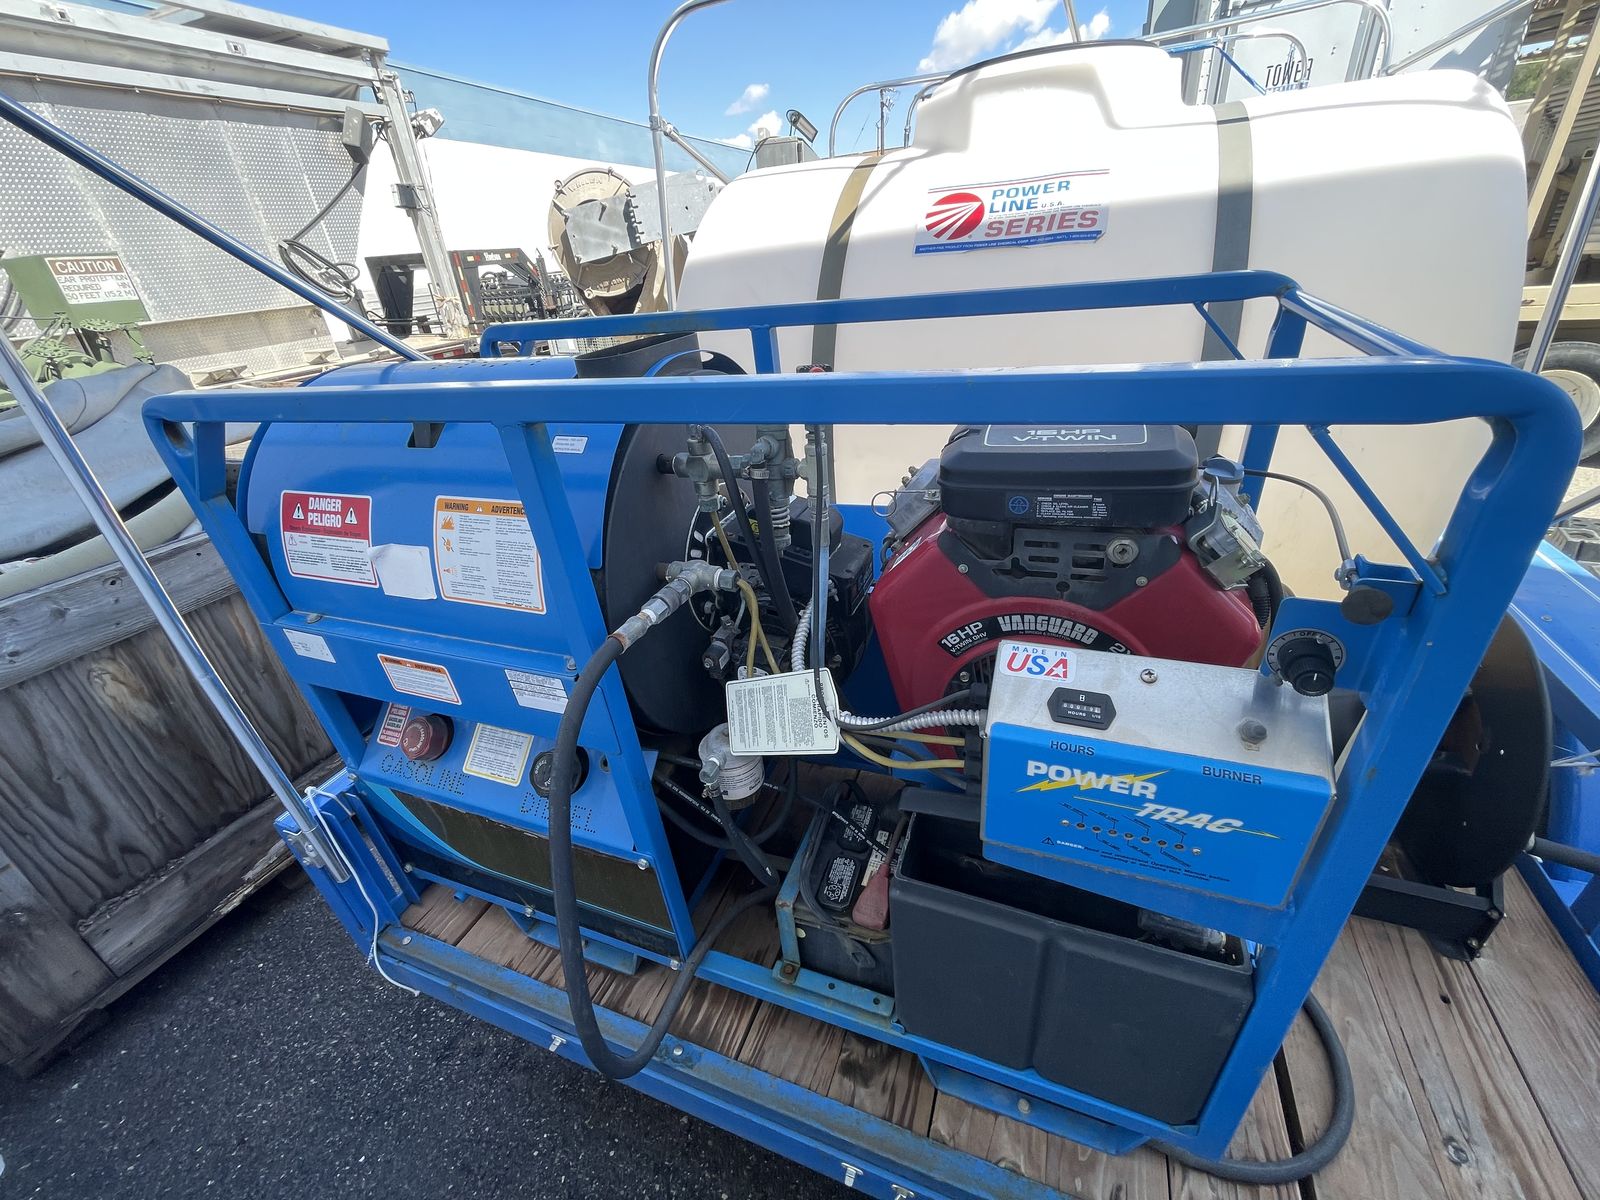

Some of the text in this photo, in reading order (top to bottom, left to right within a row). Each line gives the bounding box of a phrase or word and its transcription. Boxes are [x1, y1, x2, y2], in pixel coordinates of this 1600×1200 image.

[992, 180, 1071, 200] POWER
[989, 197, 1039, 214] LINE
[1041, 201, 1065, 209] U.S.A.
[985, 210, 1099, 238] SERIES
[55, 260, 118, 274] CAUTION
[57, 274, 129, 284] EAR PROTECTION
[62, 283, 102, 292] REQUIRED
[79, 291, 101, 300] FEET
[308, 497, 342, 512] DANGER
[444, 502, 525, 515] WARNING ADVERTENC
[307, 512, 342, 528] PELIGRO
[997, 614, 1099, 644] VANGUARD
[950, 637, 973, 653] V-TWIN
[1012, 645, 1047, 655] MADE
[1006, 652, 1069, 679] USA
[1050, 740, 1096, 756] HOURS
[381, 754, 470, 796] GASOLINE
[1026, 760, 1158, 800] POWER
[1202, 765, 1262, 785] BURNER
[1135, 802, 1244, 833] TRAC
